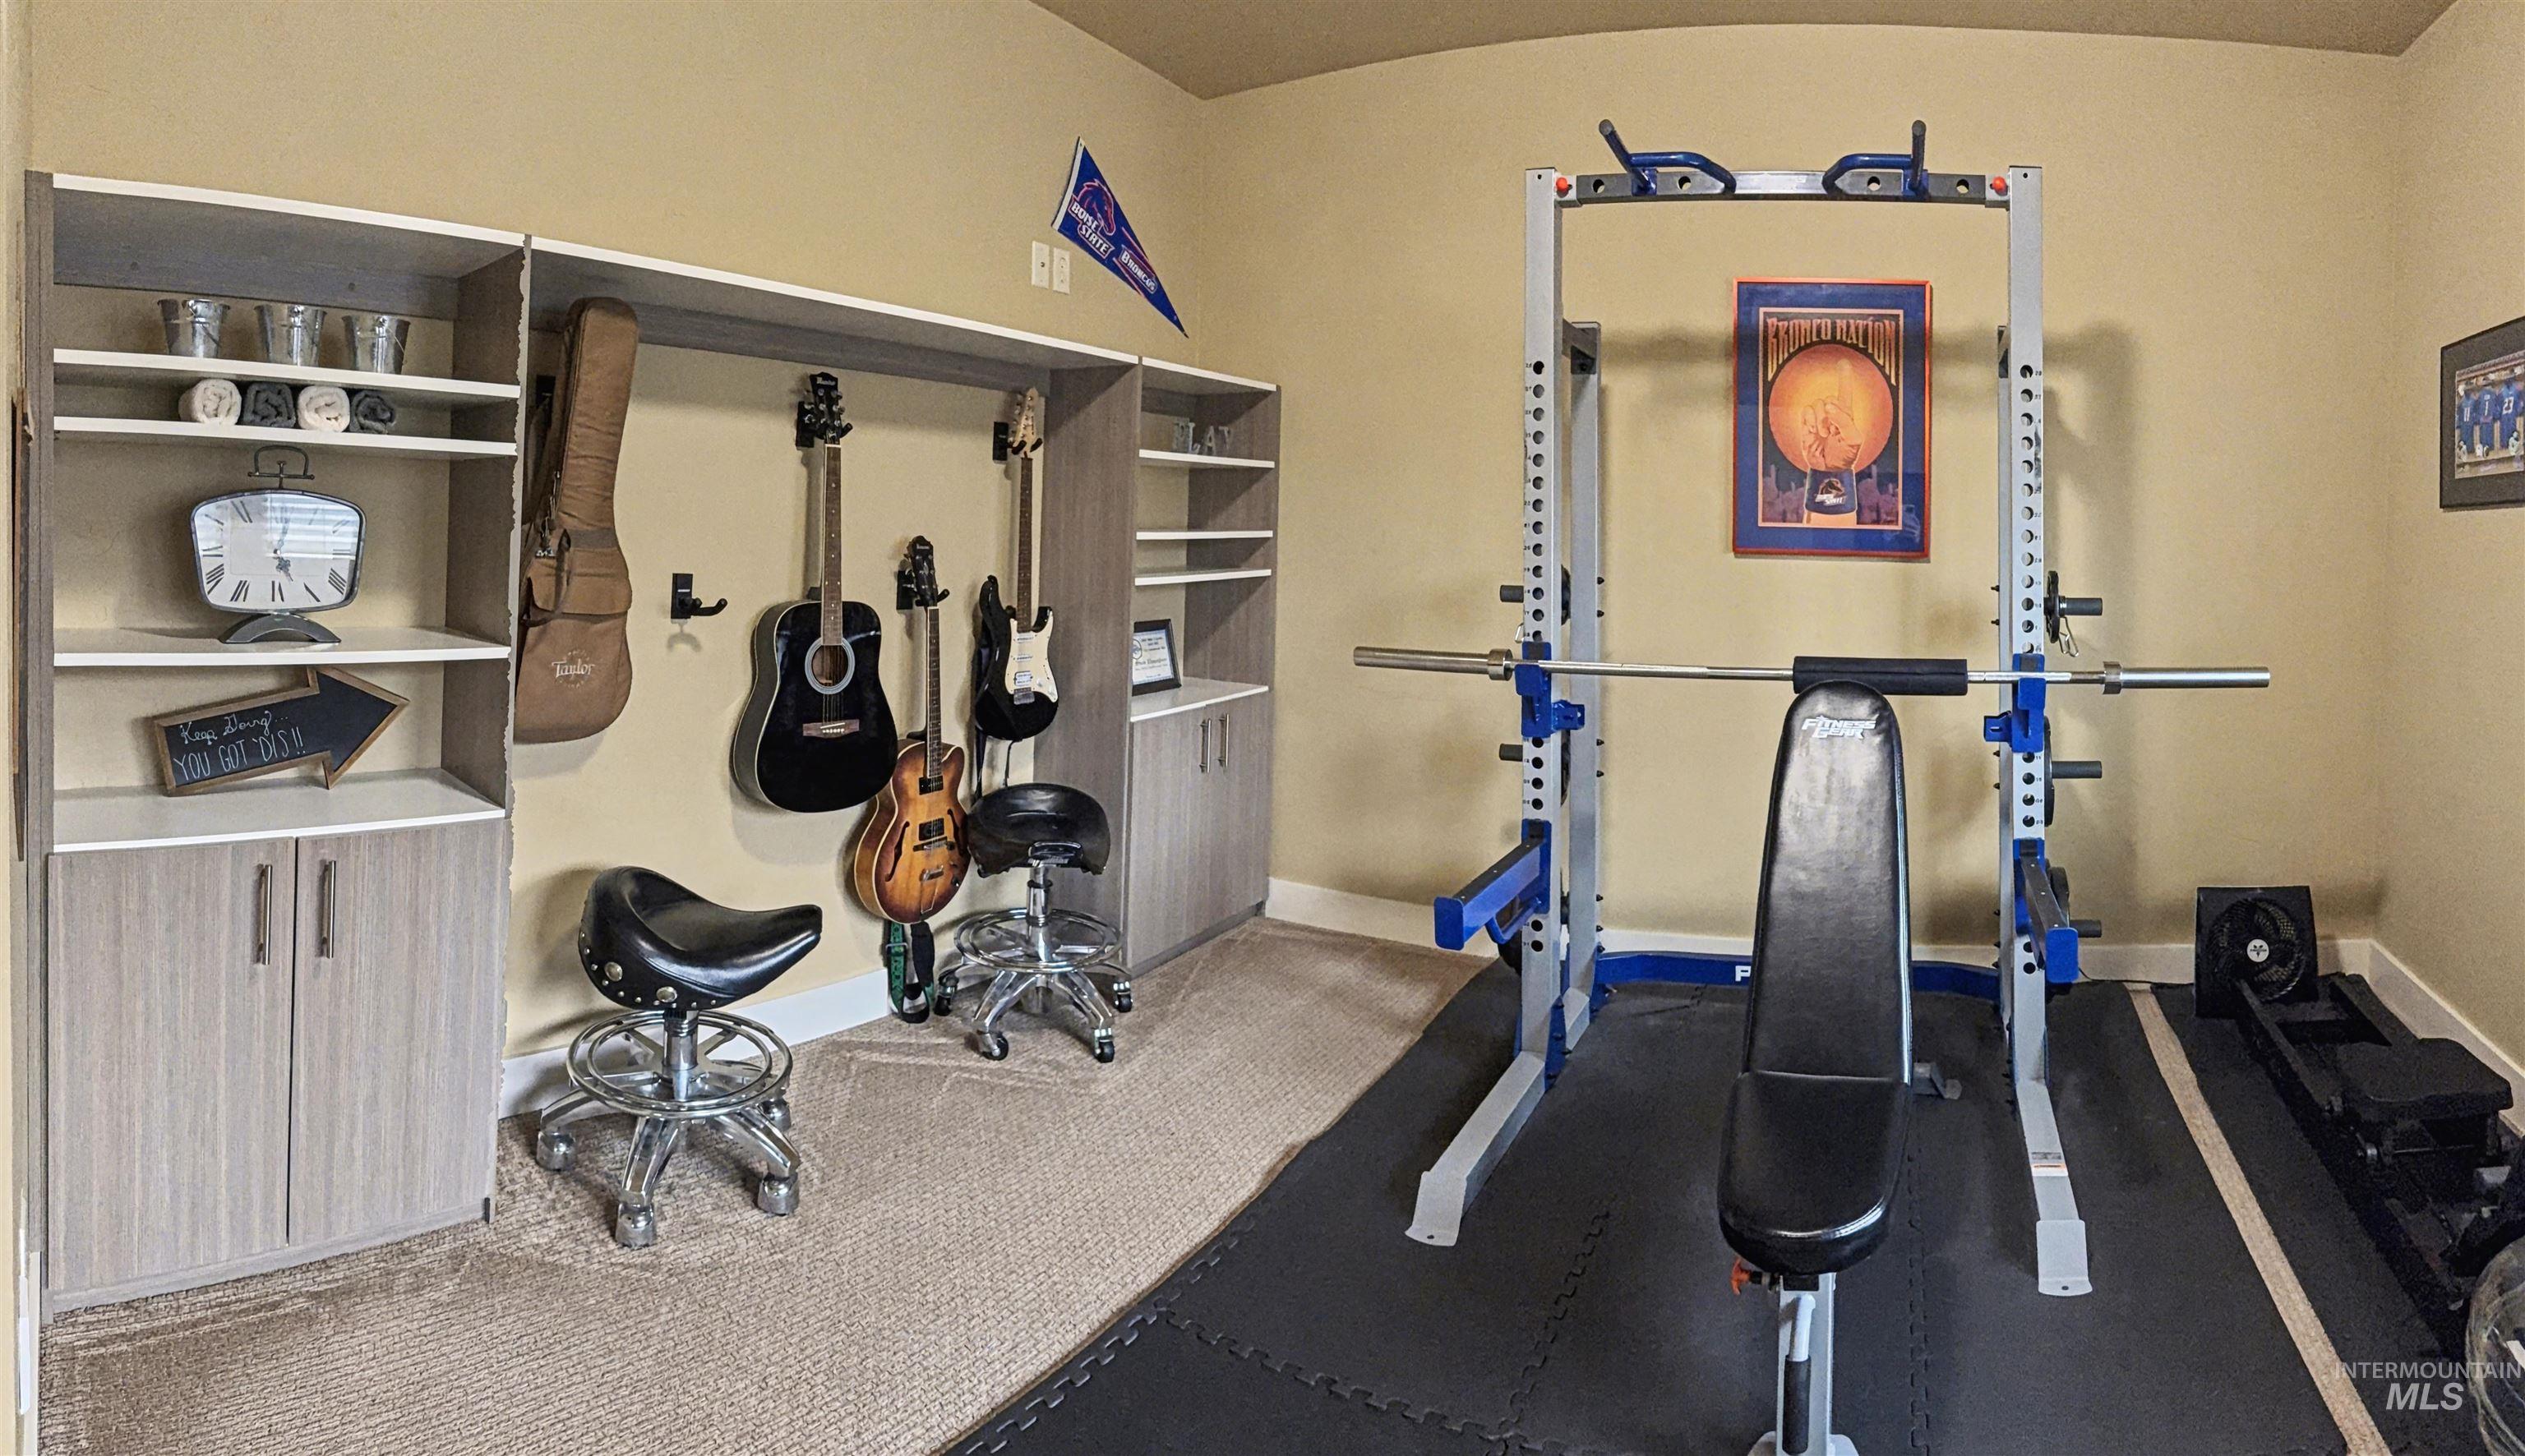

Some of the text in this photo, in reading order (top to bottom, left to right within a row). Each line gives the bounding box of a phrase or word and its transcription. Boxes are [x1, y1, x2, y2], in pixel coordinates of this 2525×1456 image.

[1071, 201, 1099, 233] BOISE
[1080, 224, 1110, 255] STATE
[1766, 316, 1897, 386] BRONCO NATION
[552, 658, 595, 680] Taylor
[179, 721, 218, 745] Keep
[1812, 726, 1865, 740] GEAR
[173, 751, 211, 781] YOU
[218, 739, 248, 773] GOT
